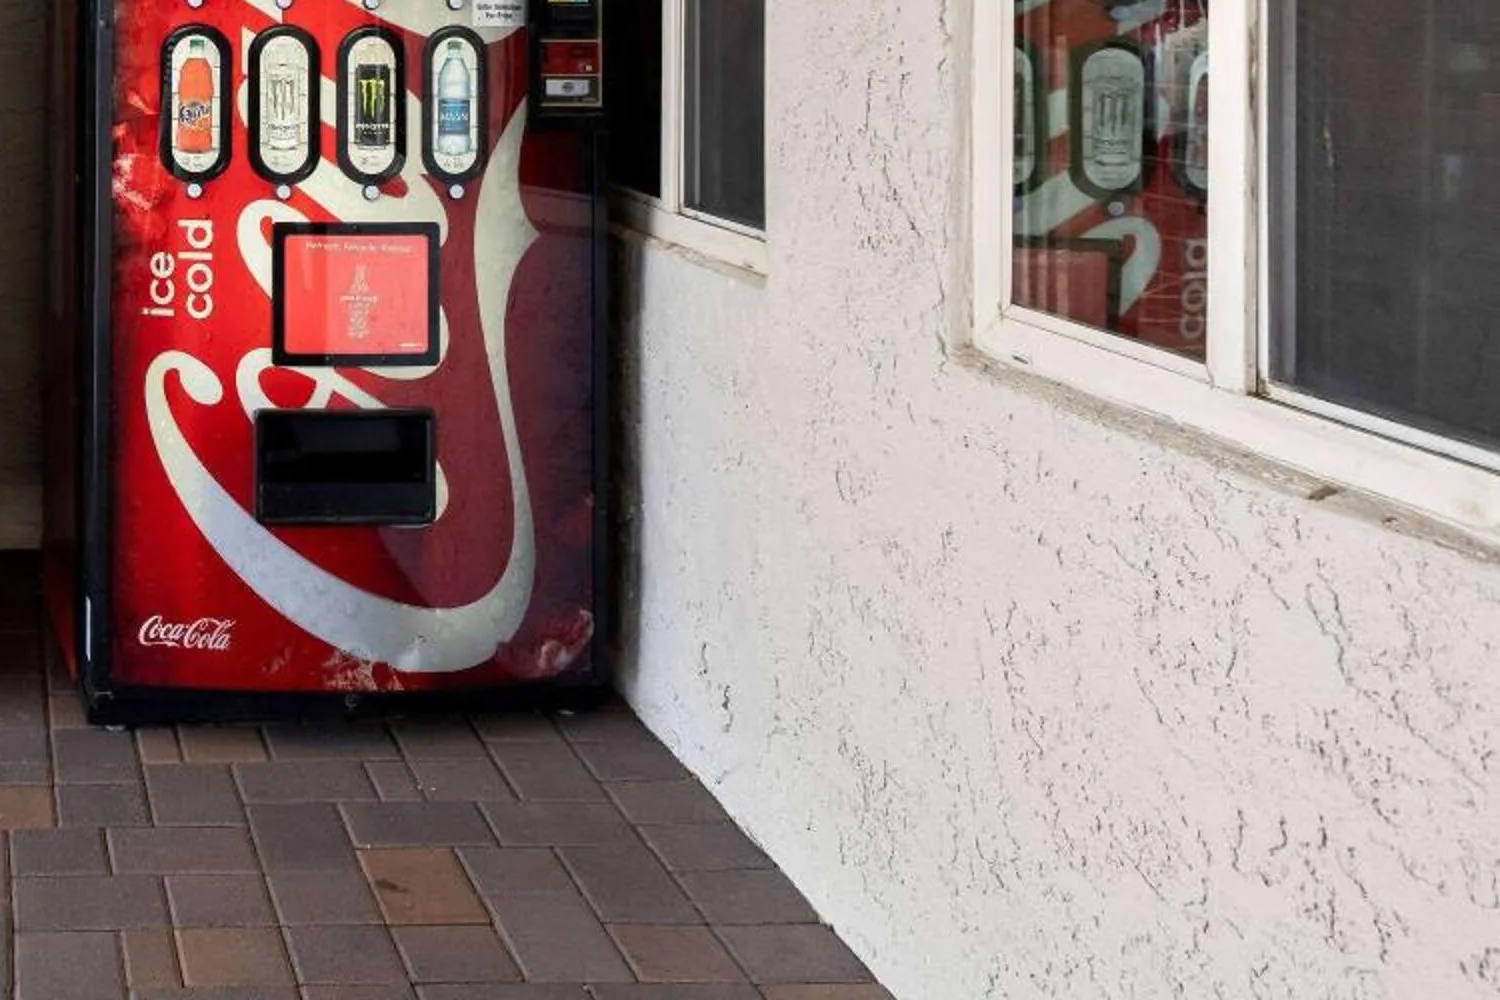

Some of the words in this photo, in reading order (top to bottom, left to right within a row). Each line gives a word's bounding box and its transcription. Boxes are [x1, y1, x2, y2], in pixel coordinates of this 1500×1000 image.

[142, 252, 175, 317] ice
[178, 219, 213, 319] cold
[138, 615, 236, 650] Coca-Cola
